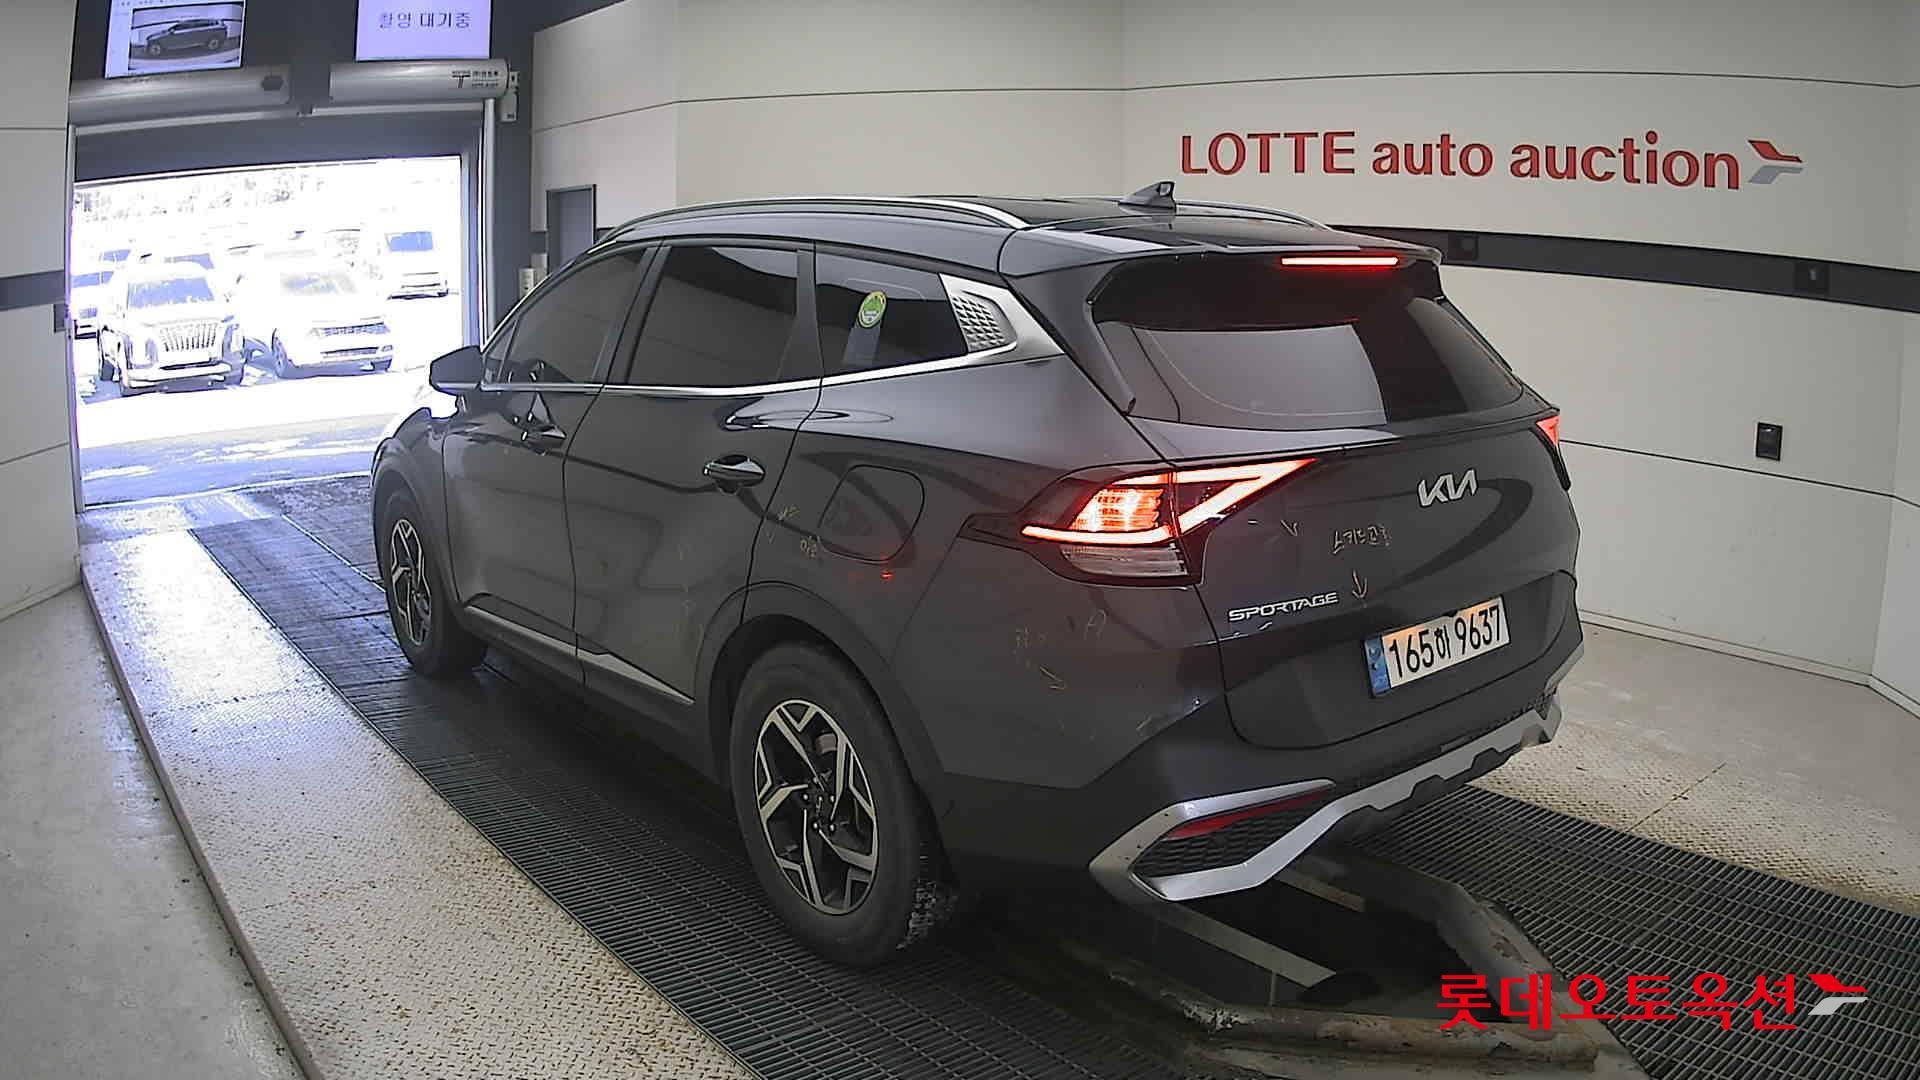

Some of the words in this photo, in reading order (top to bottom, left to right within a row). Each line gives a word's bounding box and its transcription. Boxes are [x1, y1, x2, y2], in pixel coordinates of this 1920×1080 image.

[419, 11, 473, 29] 대기중
[1181, 131, 1356, 176] LOTTE
[1372, 134, 1494, 177] auto
[1511, 131, 1740, 190] auction
[1228, 592, 1339, 622] SPORTAGE
[1389, 624, 1452, 679] 165하
[1454, 604, 1502, 655] 9637
